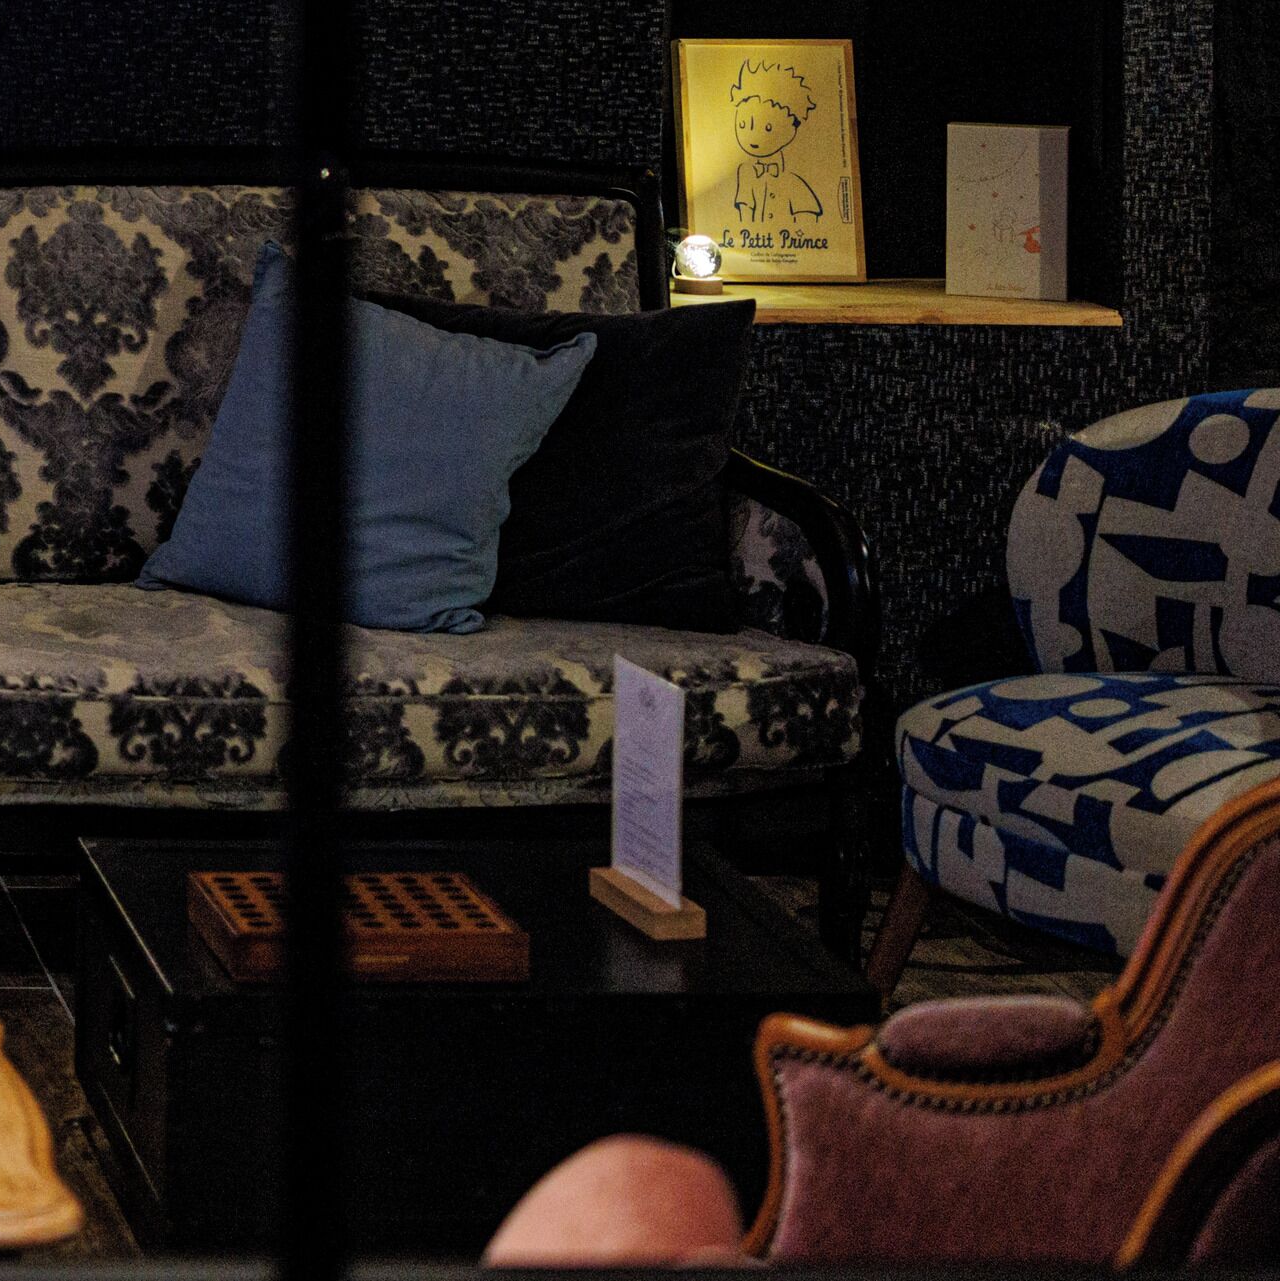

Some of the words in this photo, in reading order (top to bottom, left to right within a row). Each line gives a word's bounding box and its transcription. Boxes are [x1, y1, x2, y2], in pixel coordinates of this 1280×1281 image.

[718, 229, 735, 248] Le
[740, 228, 774, 249] Petit
[779, 228, 829, 249] Prince
